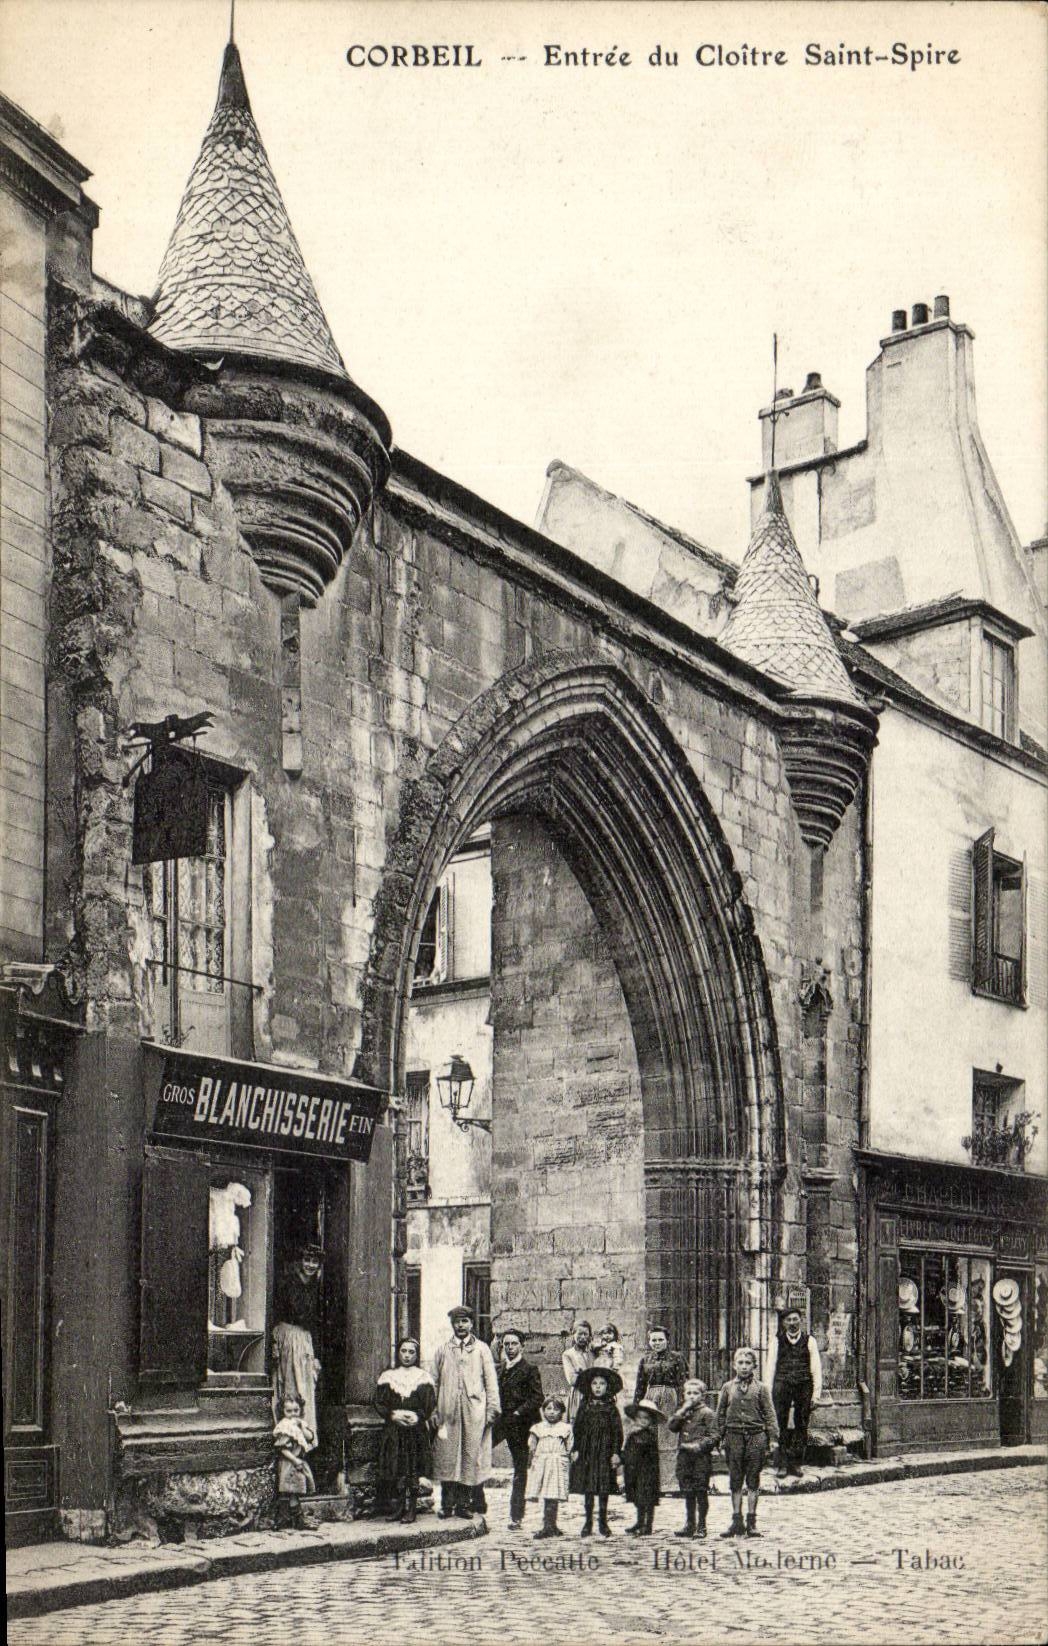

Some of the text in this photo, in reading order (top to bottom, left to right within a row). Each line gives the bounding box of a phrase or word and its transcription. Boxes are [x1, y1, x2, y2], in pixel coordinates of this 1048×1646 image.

[162, 1076, 374, 1144] GROS BLANCHISSERIE FIN
